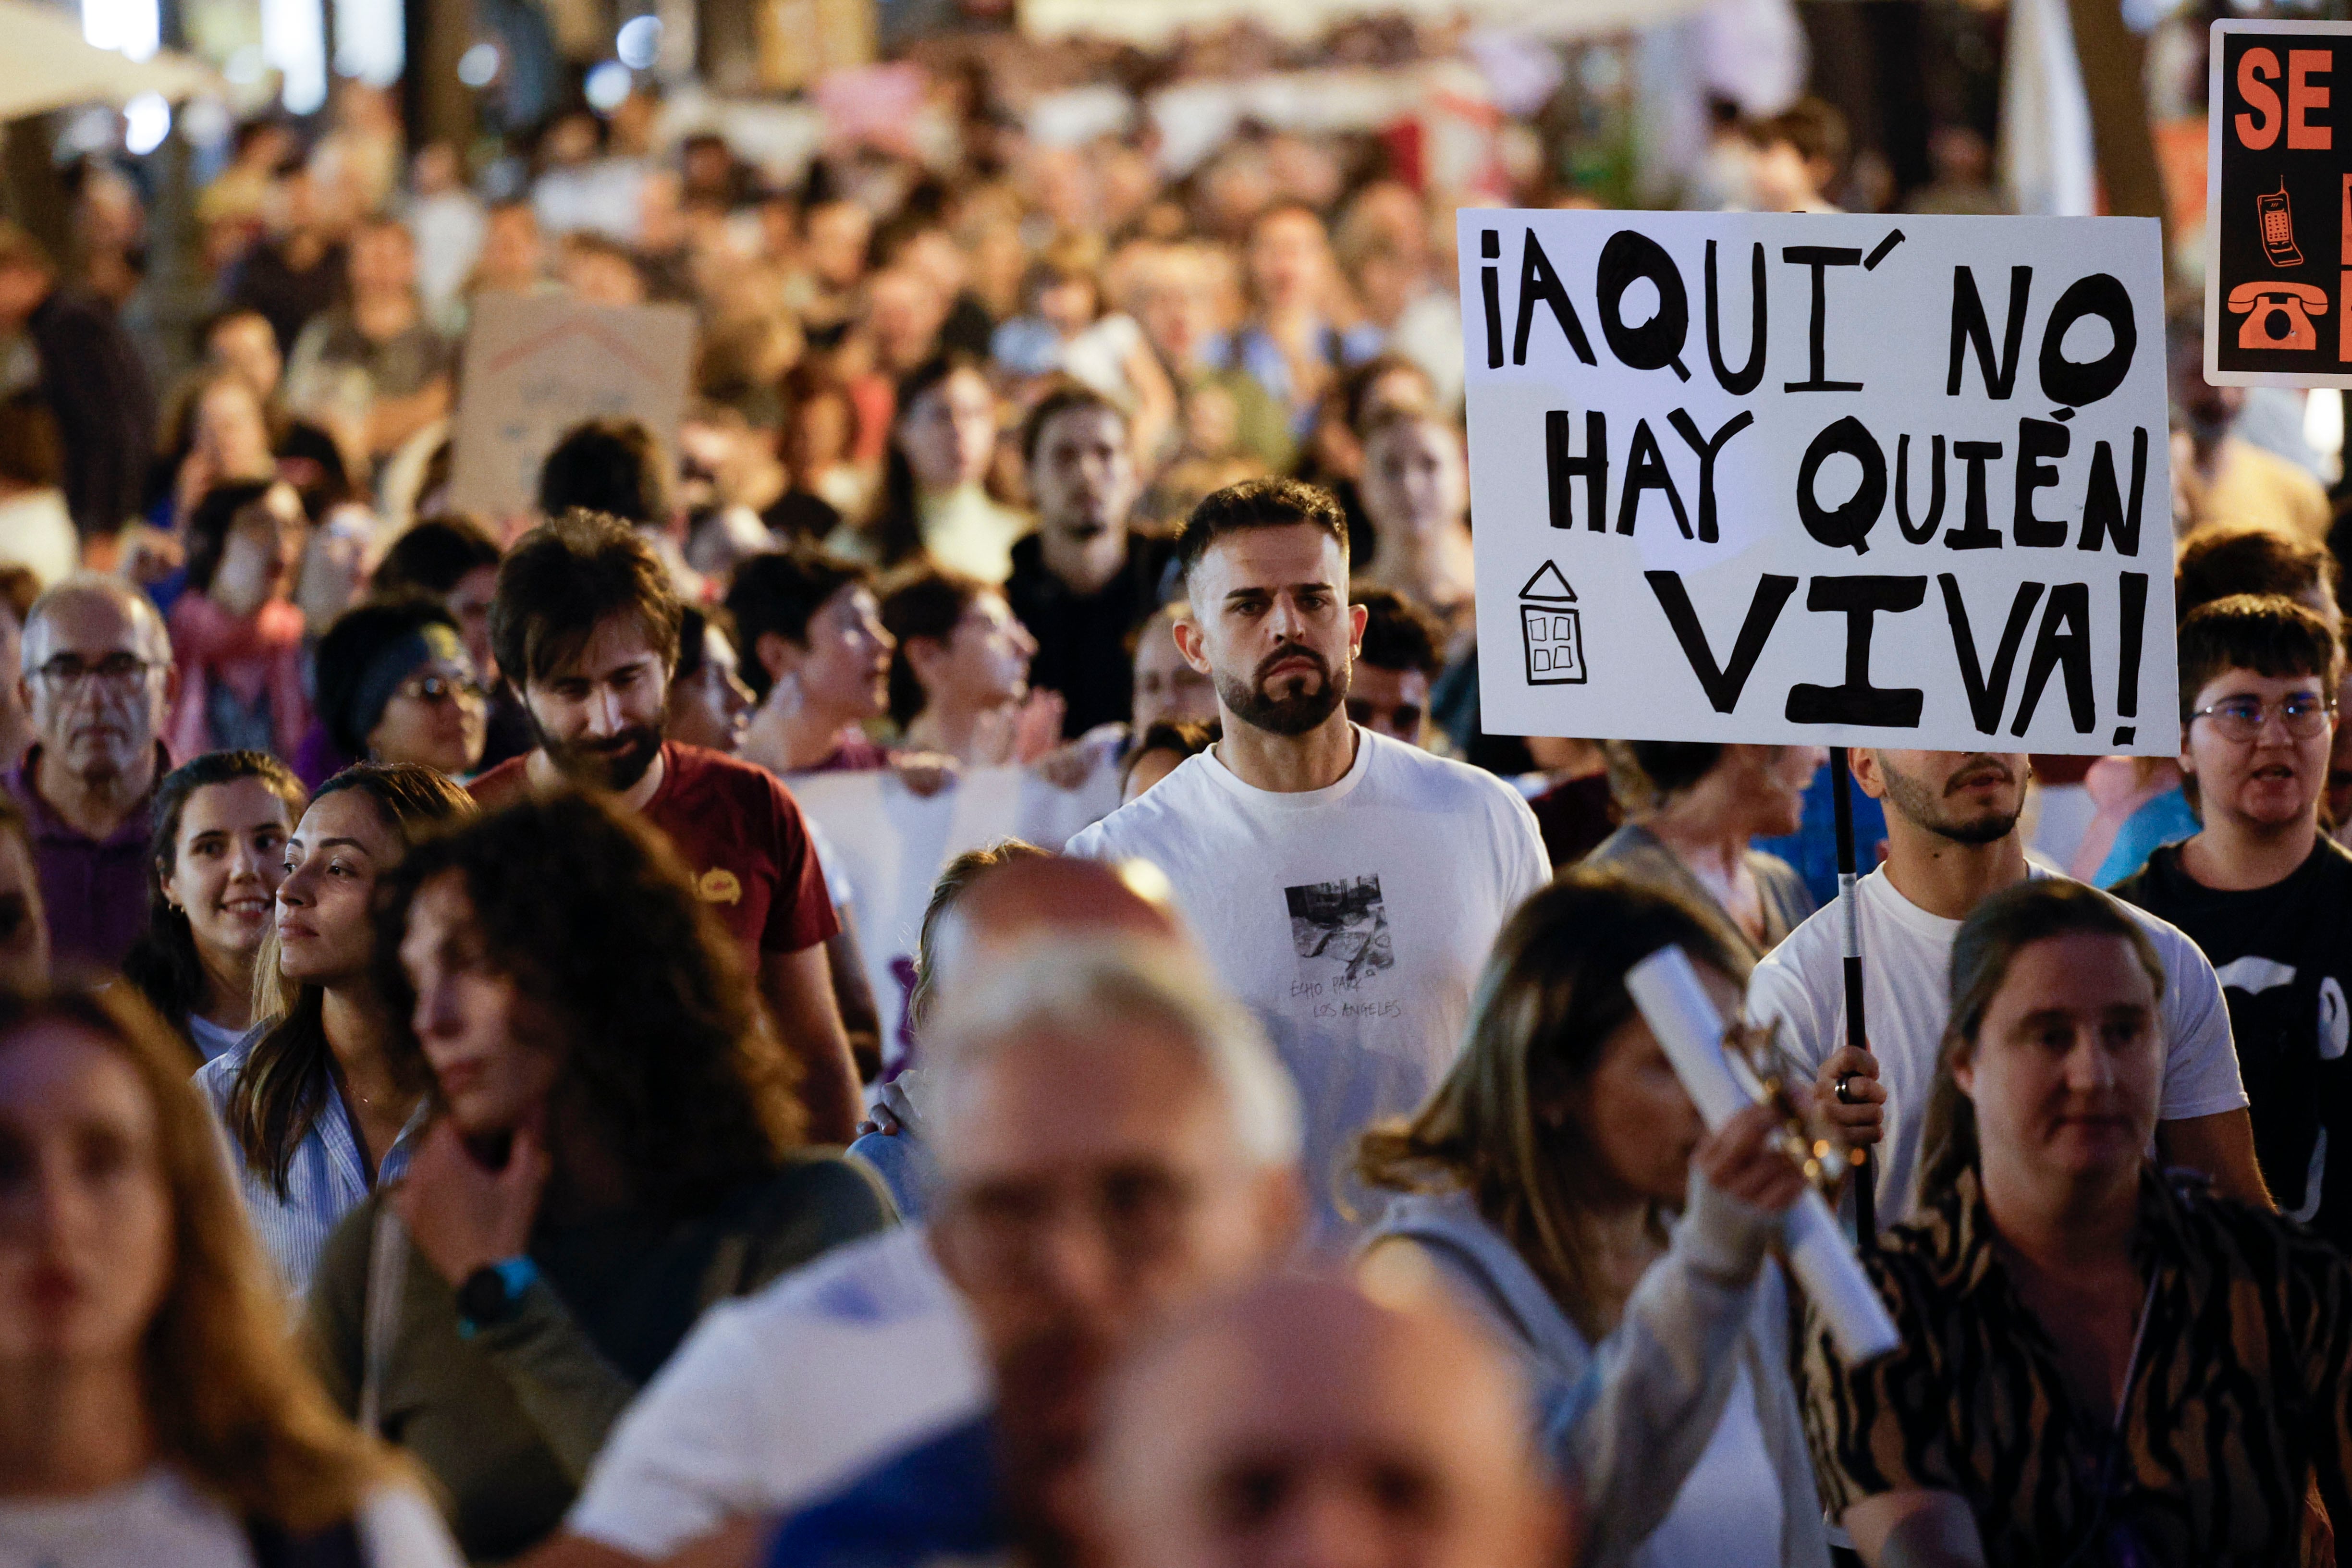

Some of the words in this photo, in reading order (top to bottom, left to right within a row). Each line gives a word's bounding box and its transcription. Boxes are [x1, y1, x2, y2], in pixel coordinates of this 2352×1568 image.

[2235, 47, 2333, 150] SE
[1947, 265, 2137, 408] NO
[1545, 407, 1754, 543] HAY
[1797, 407, 2148, 557] QUIÉN
[1643, 570, 2149, 747] VIVA!
[1290, 980, 1323, 999] ECHO
[1313, 1003, 1337, 1018] LOS
[1342, 1000, 1401, 1018] ANGELES
